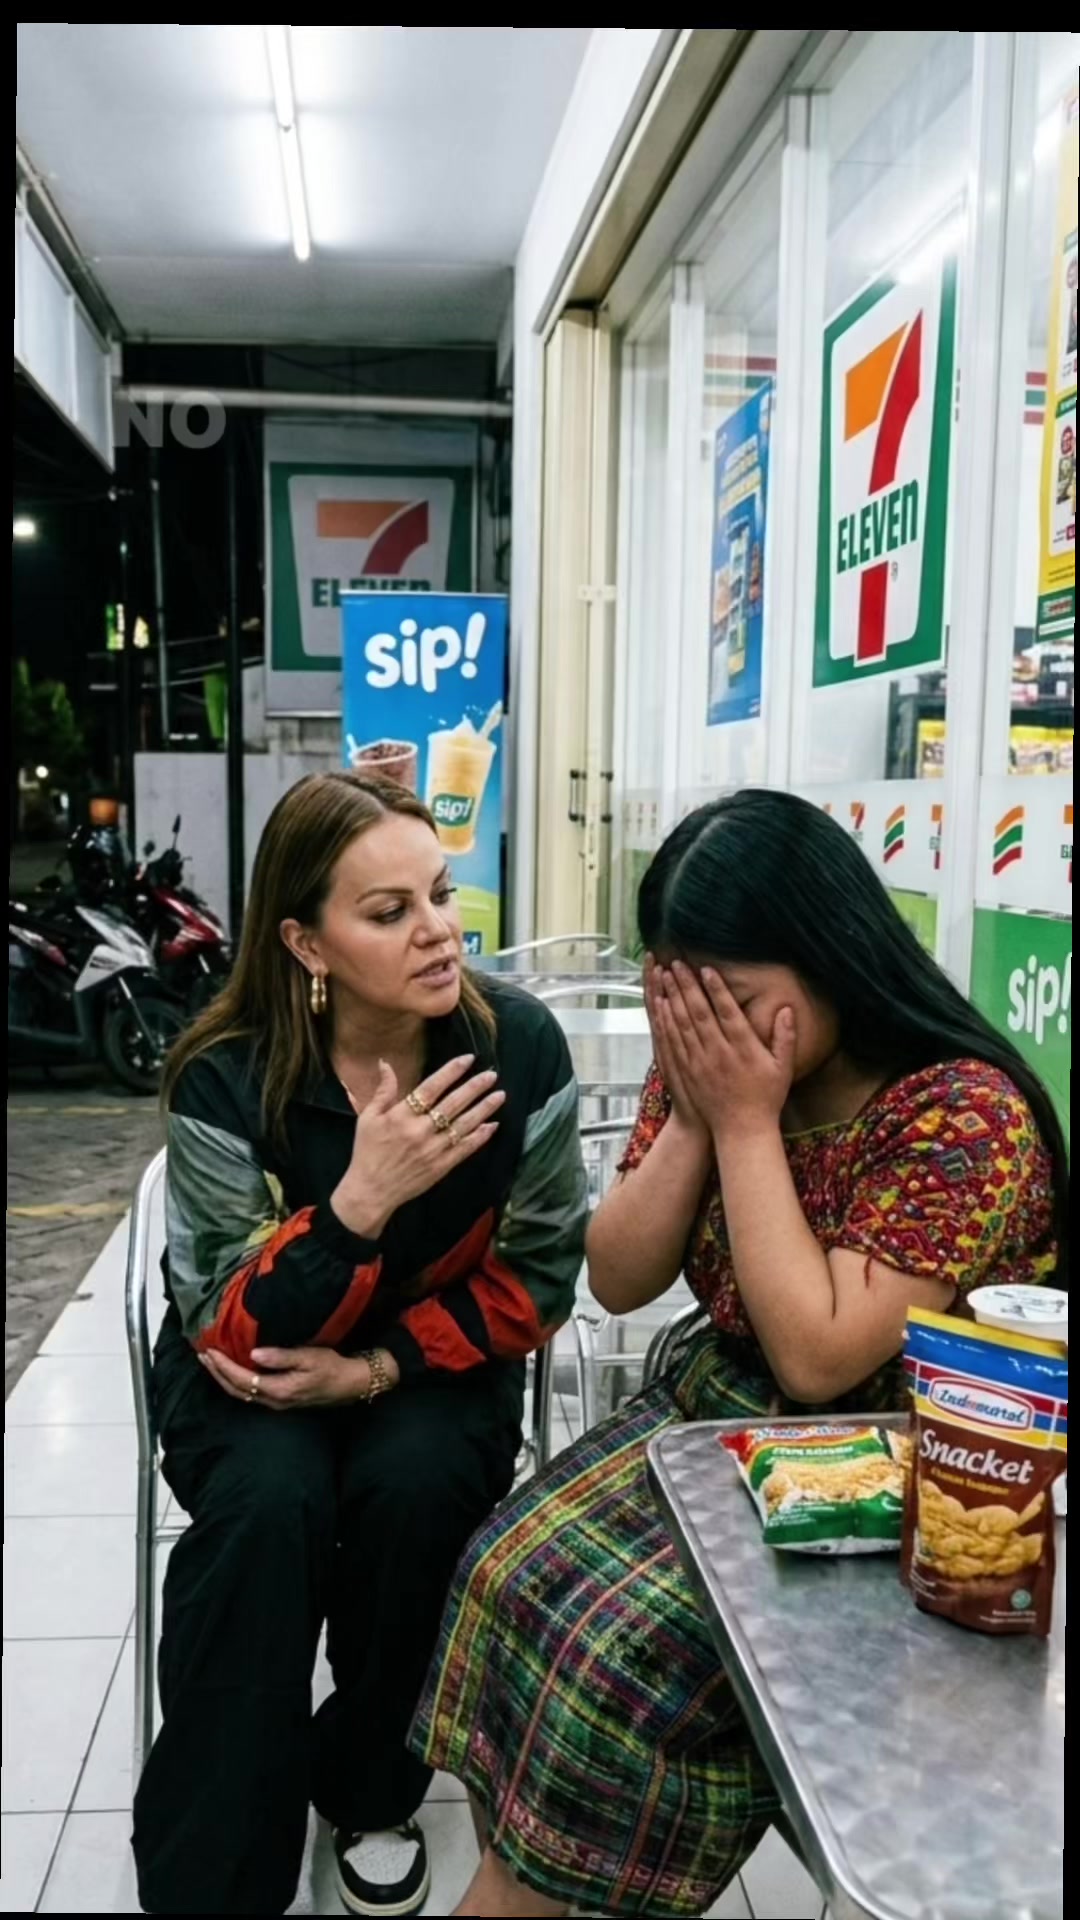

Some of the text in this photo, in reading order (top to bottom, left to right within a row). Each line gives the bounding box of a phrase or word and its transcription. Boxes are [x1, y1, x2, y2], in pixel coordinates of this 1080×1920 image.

[843, 308, 924, 661] 7
[316, 500, 429, 575] 7
[364, 611, 487, 693] sip!
[434, 798, 473, 822] sip!
[1007, 951, 1073, 1046] sip!
[919, 1428, 1035, 1485] Snacket
